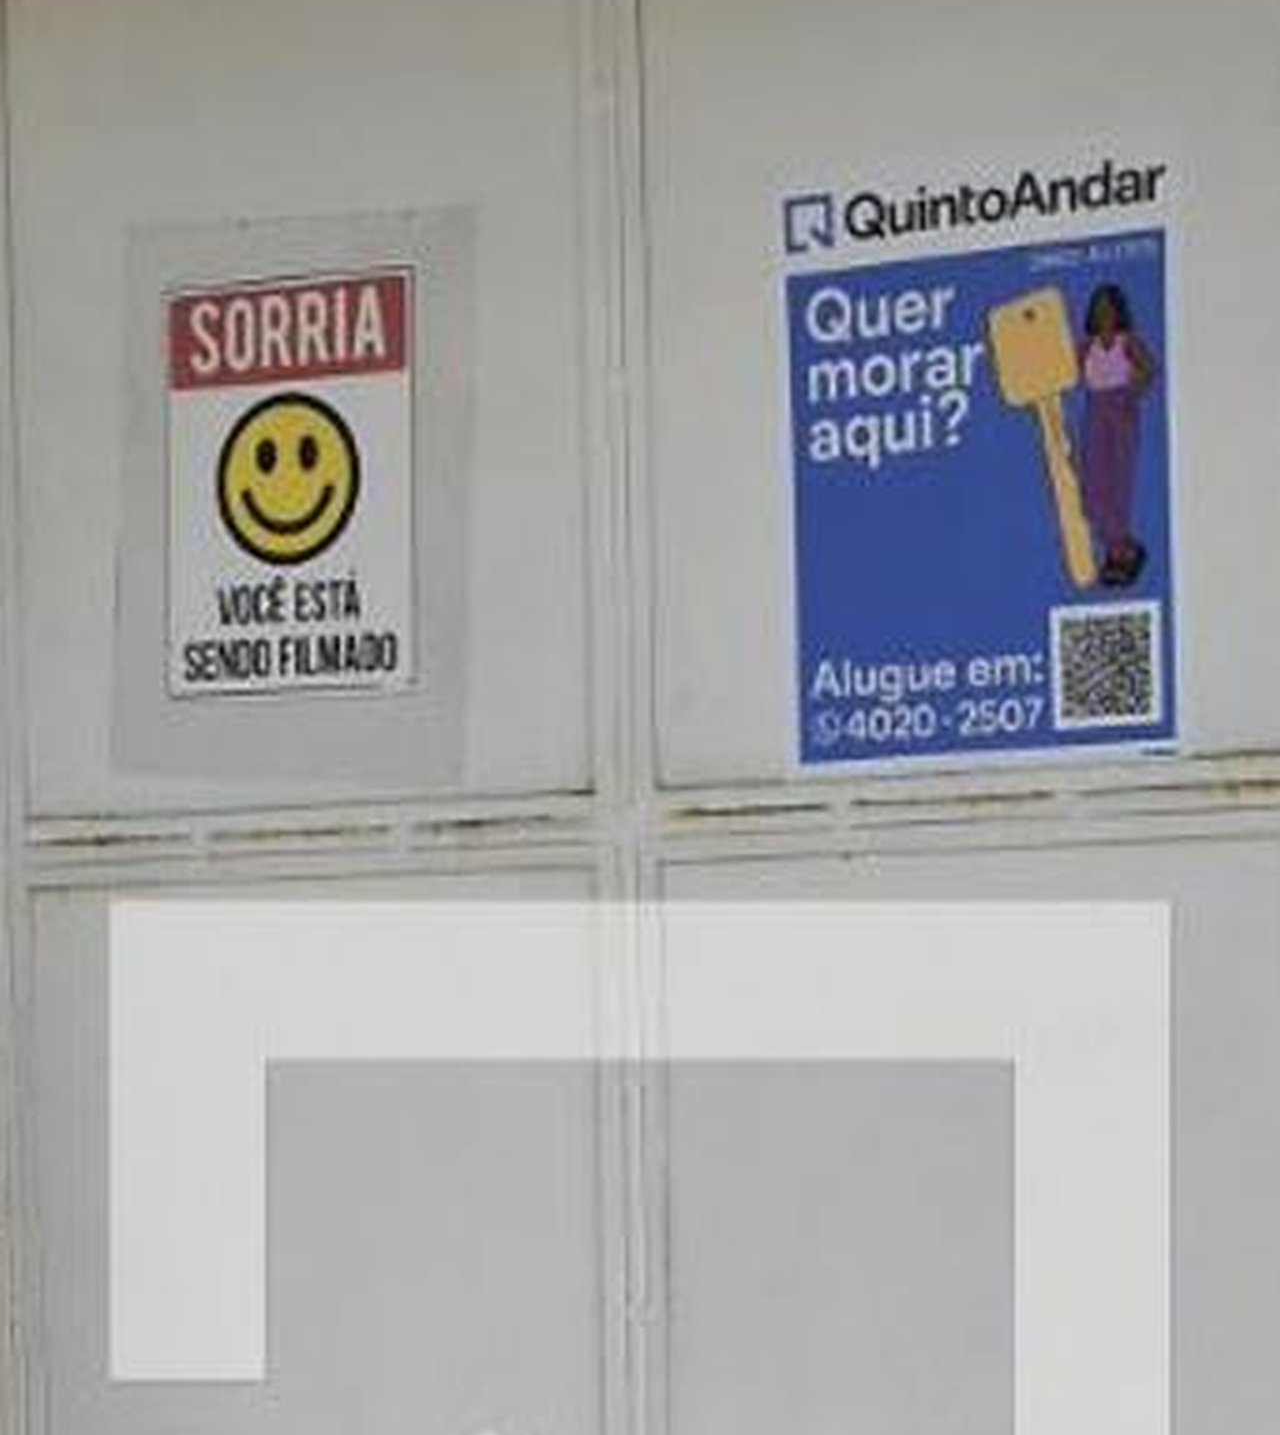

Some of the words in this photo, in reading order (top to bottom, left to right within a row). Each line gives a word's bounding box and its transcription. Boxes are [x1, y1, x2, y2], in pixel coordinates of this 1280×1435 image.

[844, 160, 1166, 239] QuintoAndar
[189, 285, 387, 374] SORRIA
[806, 285, 955, 344] Quer
[808, 342, 984, 403] morar
[808, 390, 969, 470] aqui?
[218, 574, 286, 625] VOCÊ
[184, 637, 271, 682] SENDO
[278, 632, 398, 678] FILMADO
[813, 659, 957, 702] Alugue
[970, 652, 1043, 687] em:
